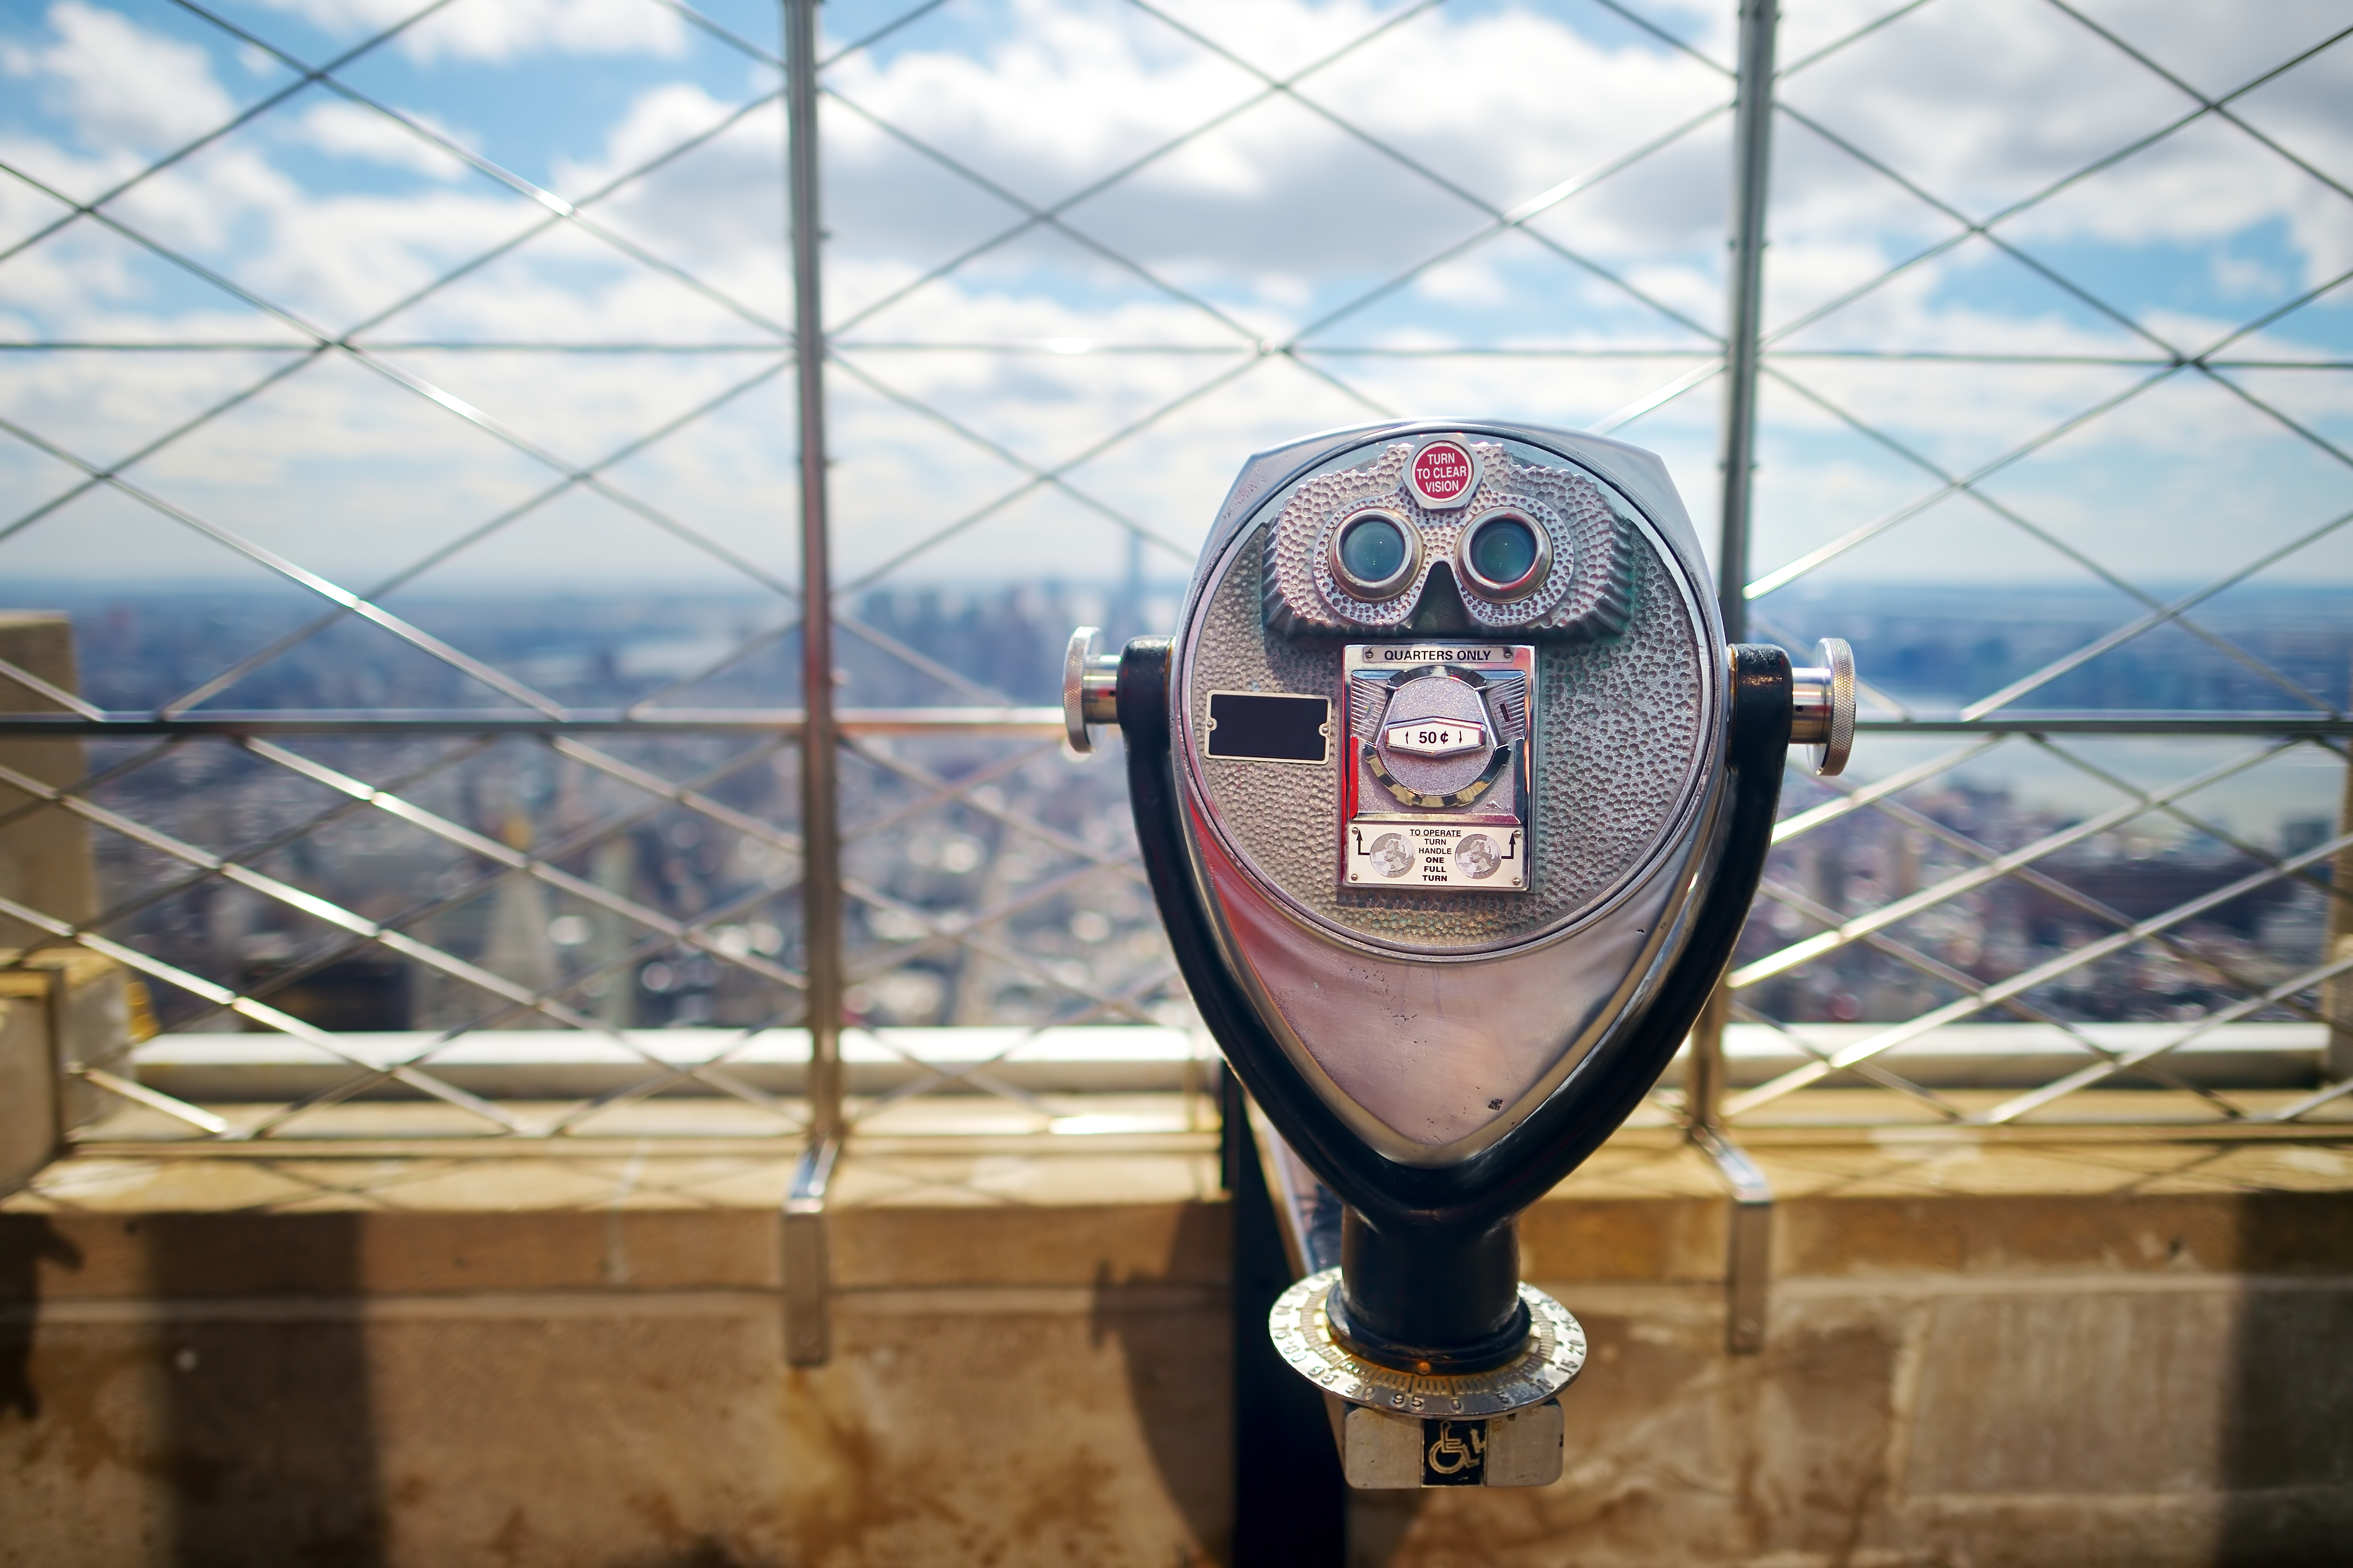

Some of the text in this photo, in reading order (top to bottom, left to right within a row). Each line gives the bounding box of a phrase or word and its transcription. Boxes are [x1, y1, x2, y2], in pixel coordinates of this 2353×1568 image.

[1427, 452, 1455, 465] TURN
[1416, 465, 1467, 480] TO CLEAR
[1425, 480, 1459, 493] VISION
[1384, 650, 1491, 660] QUARTERS ONLY
[1393, 1394, 1424, 1407] 95
